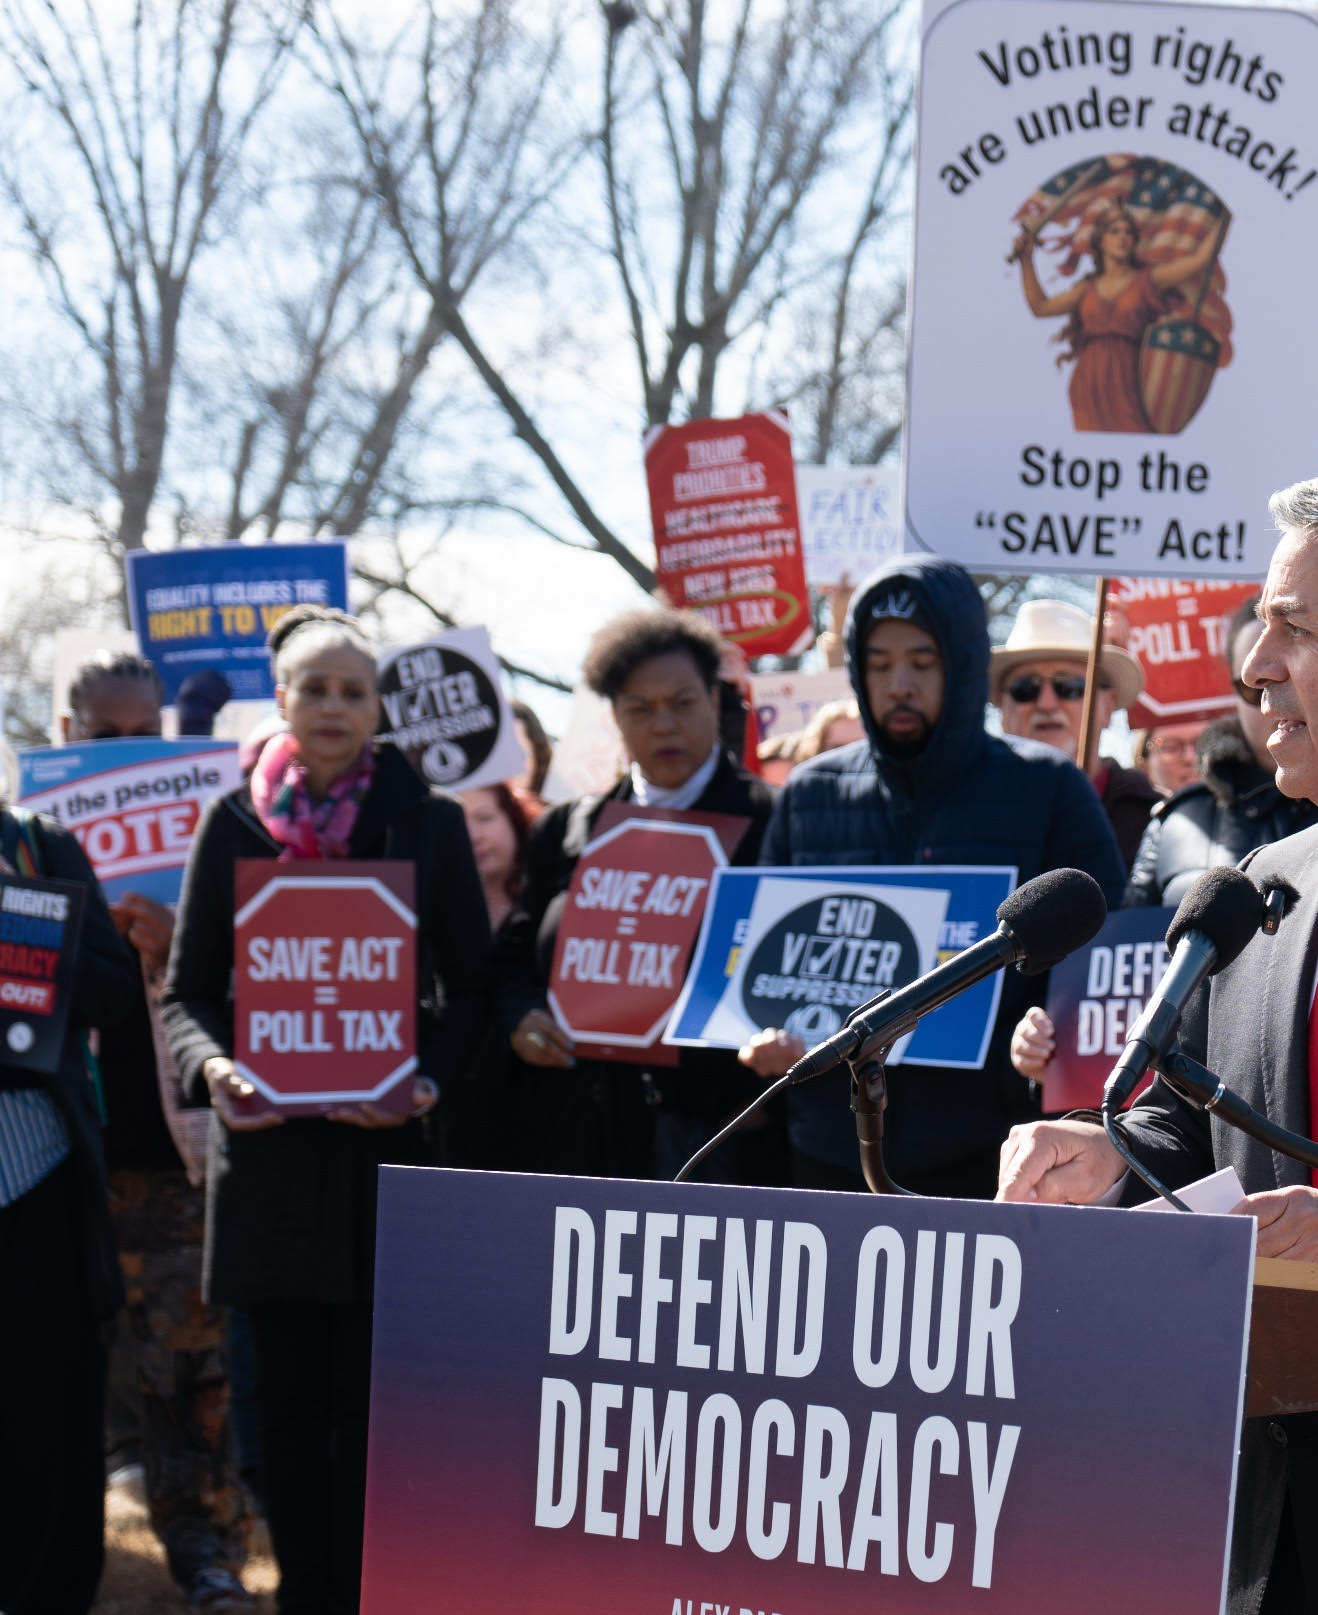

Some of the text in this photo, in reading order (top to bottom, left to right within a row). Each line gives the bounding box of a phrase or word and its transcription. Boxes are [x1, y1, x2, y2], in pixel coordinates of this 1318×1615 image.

[978, 27, 1285, 103] Voting rights
[939, 88, 1318, 201] are under attack!
[1020, 444, 1209, 499] Stop the
[808, 487, 889, 525] FAIR
[1158, 520, 1246, 561] Act!
[218, 604, 256, 635] TO
[396, 649, 444, 688] END
[67, 792, 107, 816] the
[114, 767, 220, 808] people
[575, 867, 708, 917] SAVE ACT
[817, 898, 876, 938] END
[247, 937, 404, 981] SAVE ACT
[560, 937, 620, 984] POLL
[627, 941, 680, 988] TAX
[249, 1010, 403, 1053] POLL TAX
[549, 1206, 1023, 1399] DEFEND OUR
[535, 1377, 1022, 1590] DEMOCRACY
